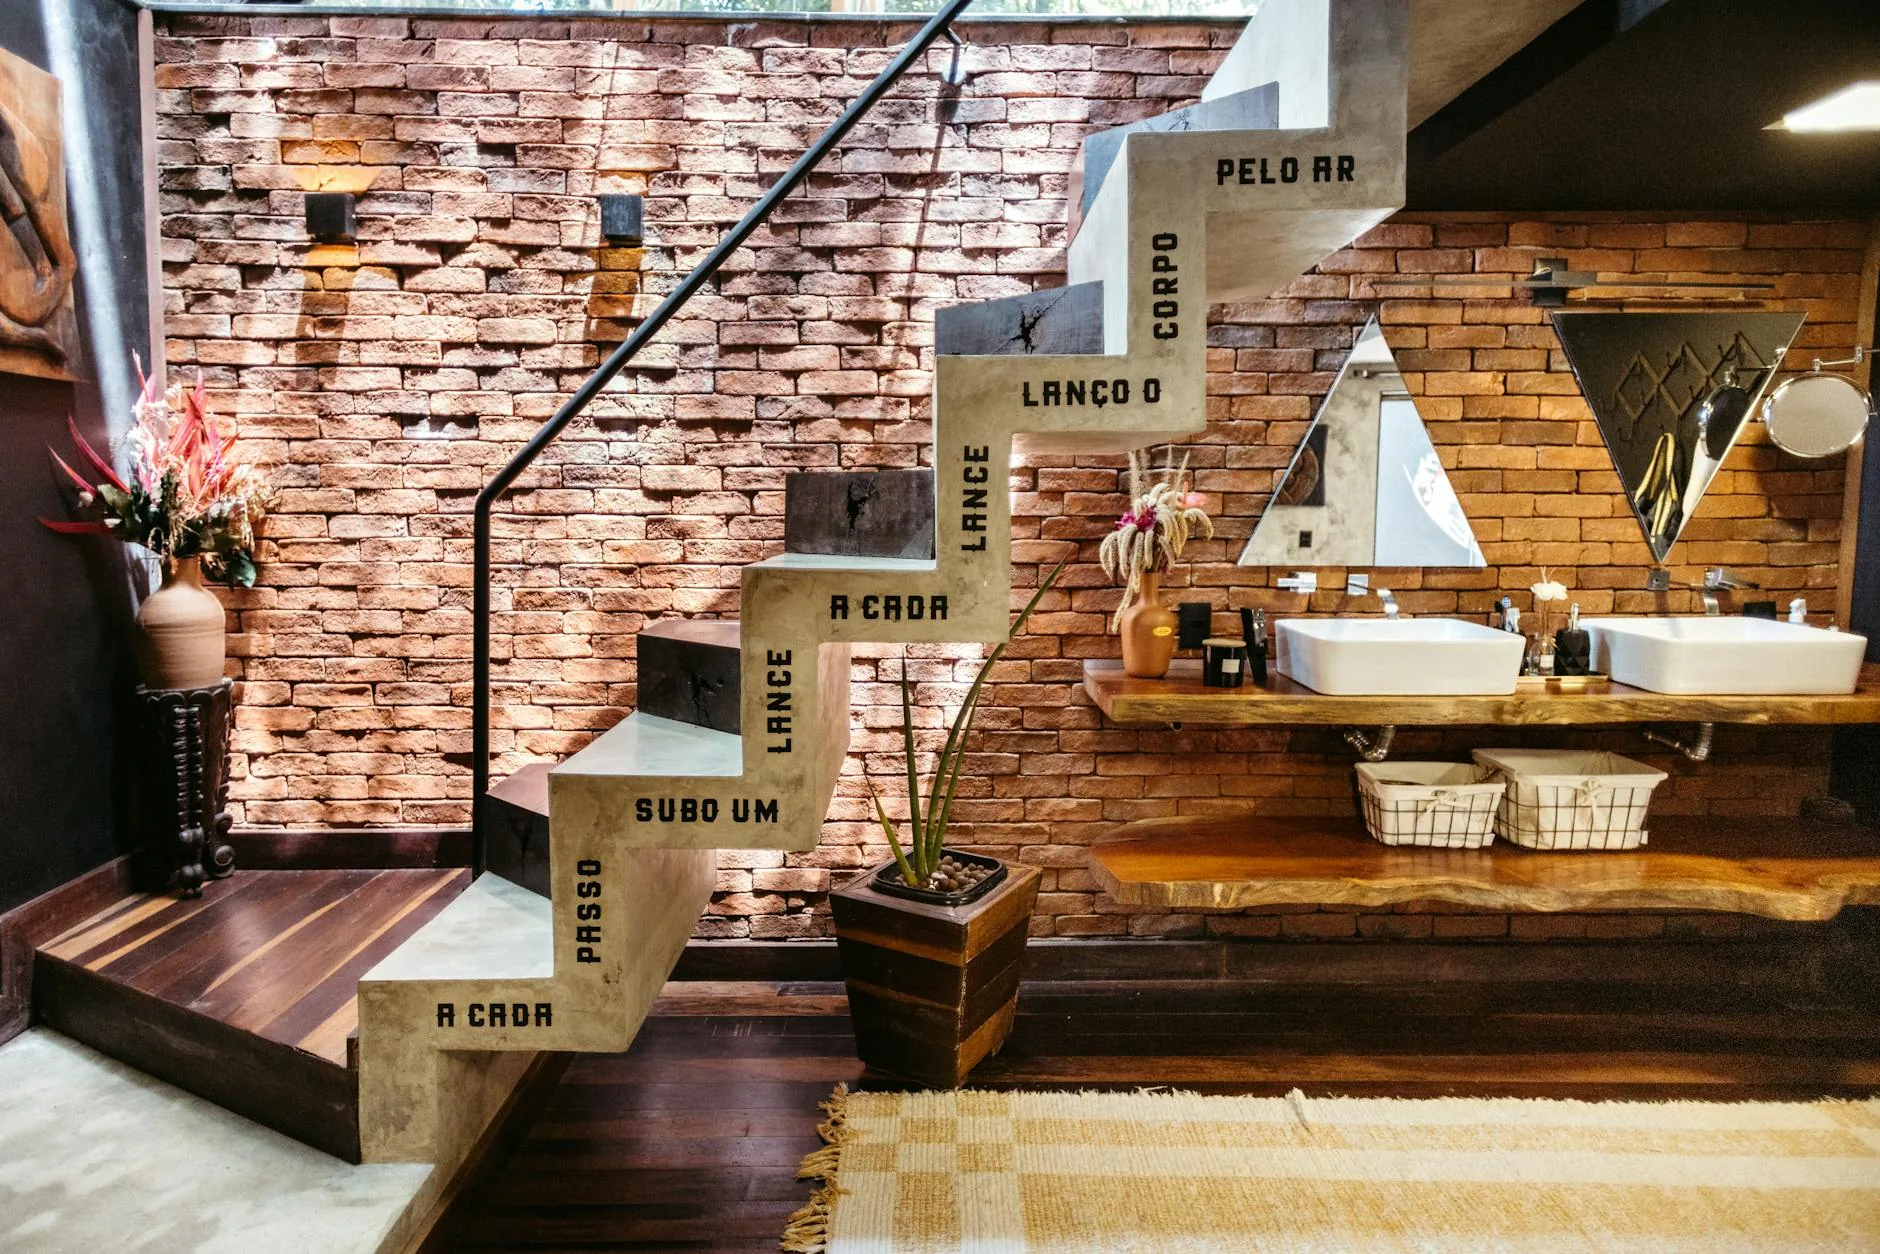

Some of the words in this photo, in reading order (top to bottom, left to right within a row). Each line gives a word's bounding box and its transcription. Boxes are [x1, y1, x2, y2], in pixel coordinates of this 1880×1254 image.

[1216, 157, 1299, 186] PELO
[1312, 155, 1354, 182] AR
[1152, 232, 1178, 340] CORPO
[1022, 379, 1130, 408] LANÇO
[1143, 378, 1161, 403] O
[961, 446, 988, 552] LANCE
[830, 595, 849, 619] A
[862, 595, 948, 620] CADA
[767, 650, 791, 754] LANCE
[635, 798, 719, 823] SUBO
[732, 799, 779, 823] UM
[576, 859, 601, 963] PASSO
[436, 1003, 455, 1027] A
[468, 1003, 552, 1027] CADA
